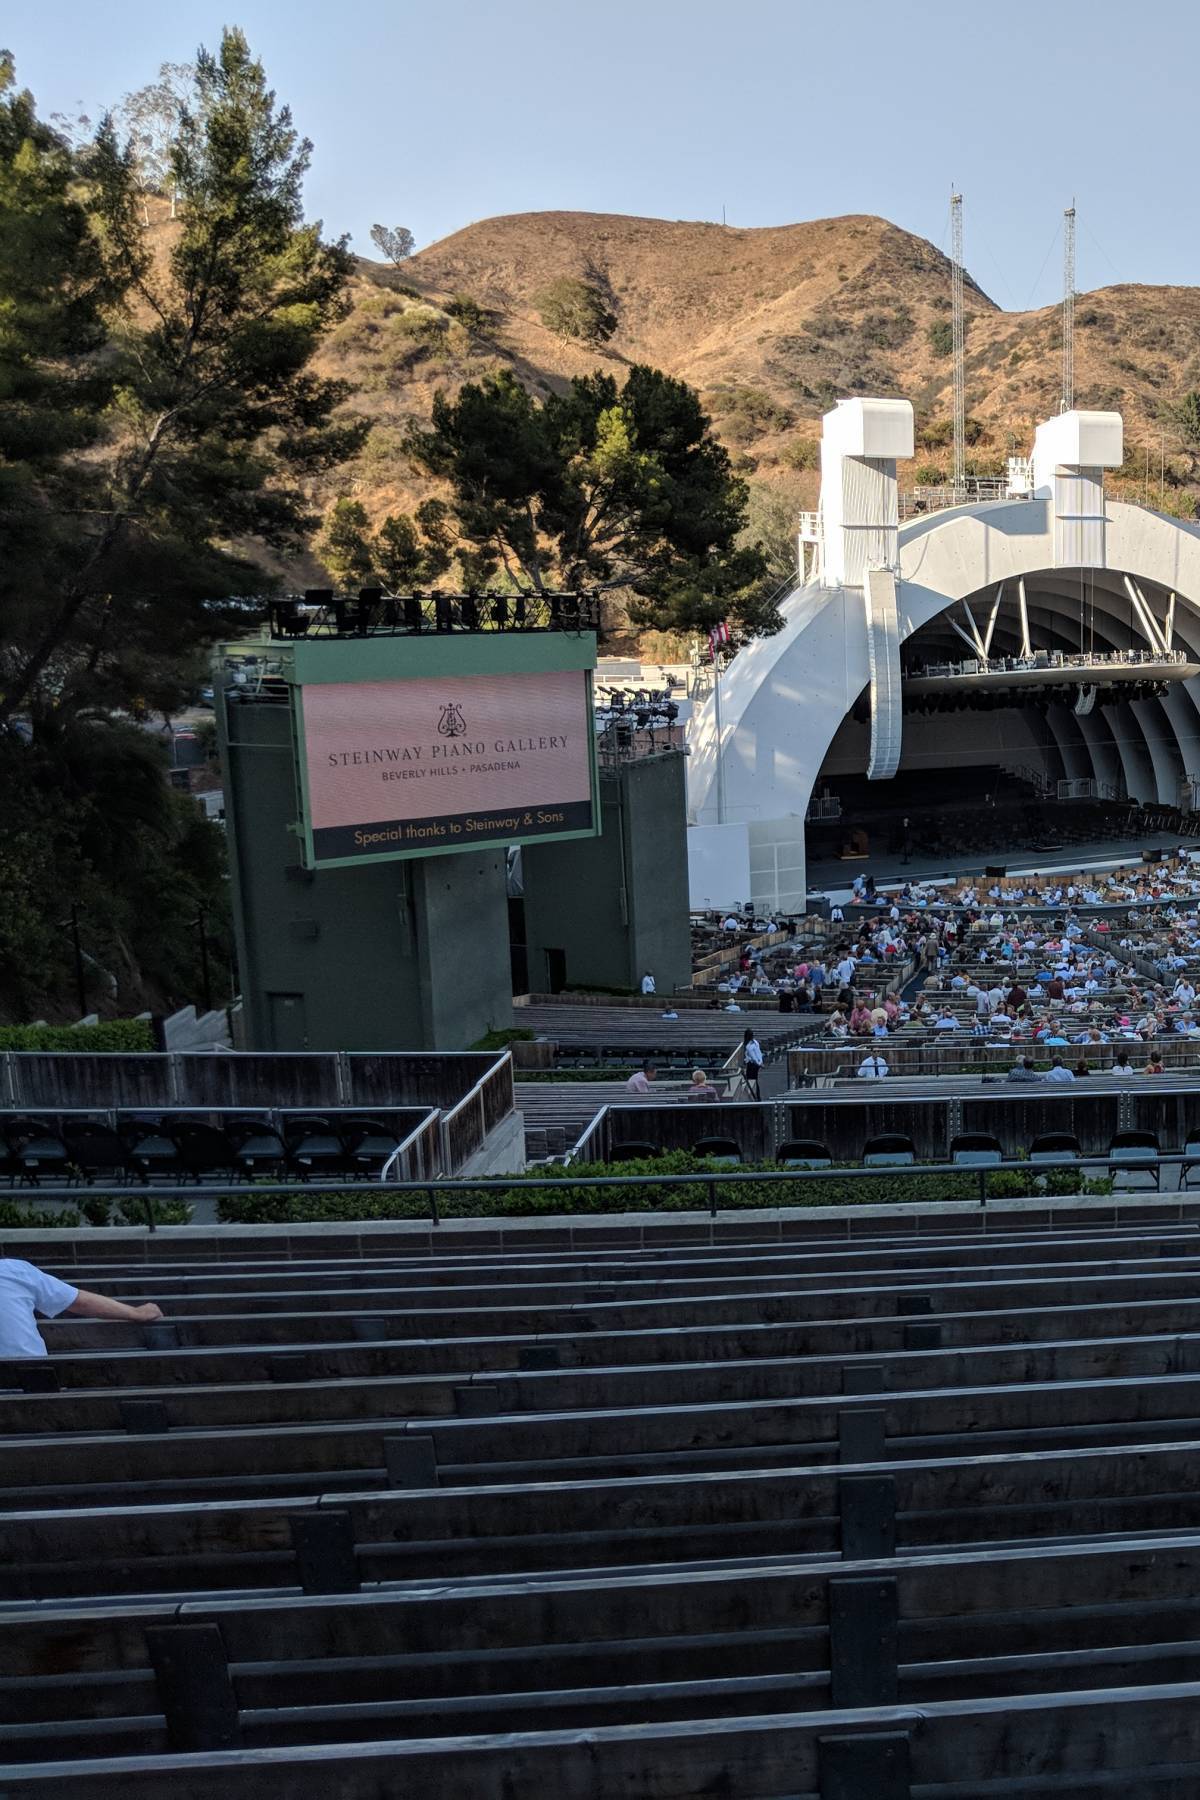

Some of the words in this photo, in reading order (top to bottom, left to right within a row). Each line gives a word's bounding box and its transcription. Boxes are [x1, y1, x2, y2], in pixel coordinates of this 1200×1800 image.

[328, 746, 422, 767] STEINWAY
[432, 742, 485, 758] PIANO
[494, 735, 568, 753] GALLERY
[382, 768, 426, 782] BEVERLY
[430, 765, 458, 776] HILLS
[470, 761, 520, 773] PASADENA
[354, 825, 402, 847] Special
[406, 822, 446, 839] thanks
[450, 822, 462, 834] to
[465, 817, 520, 832] Steinway
[523, 812, 533, 825] &
[536, 810, 565, 823] Sons
